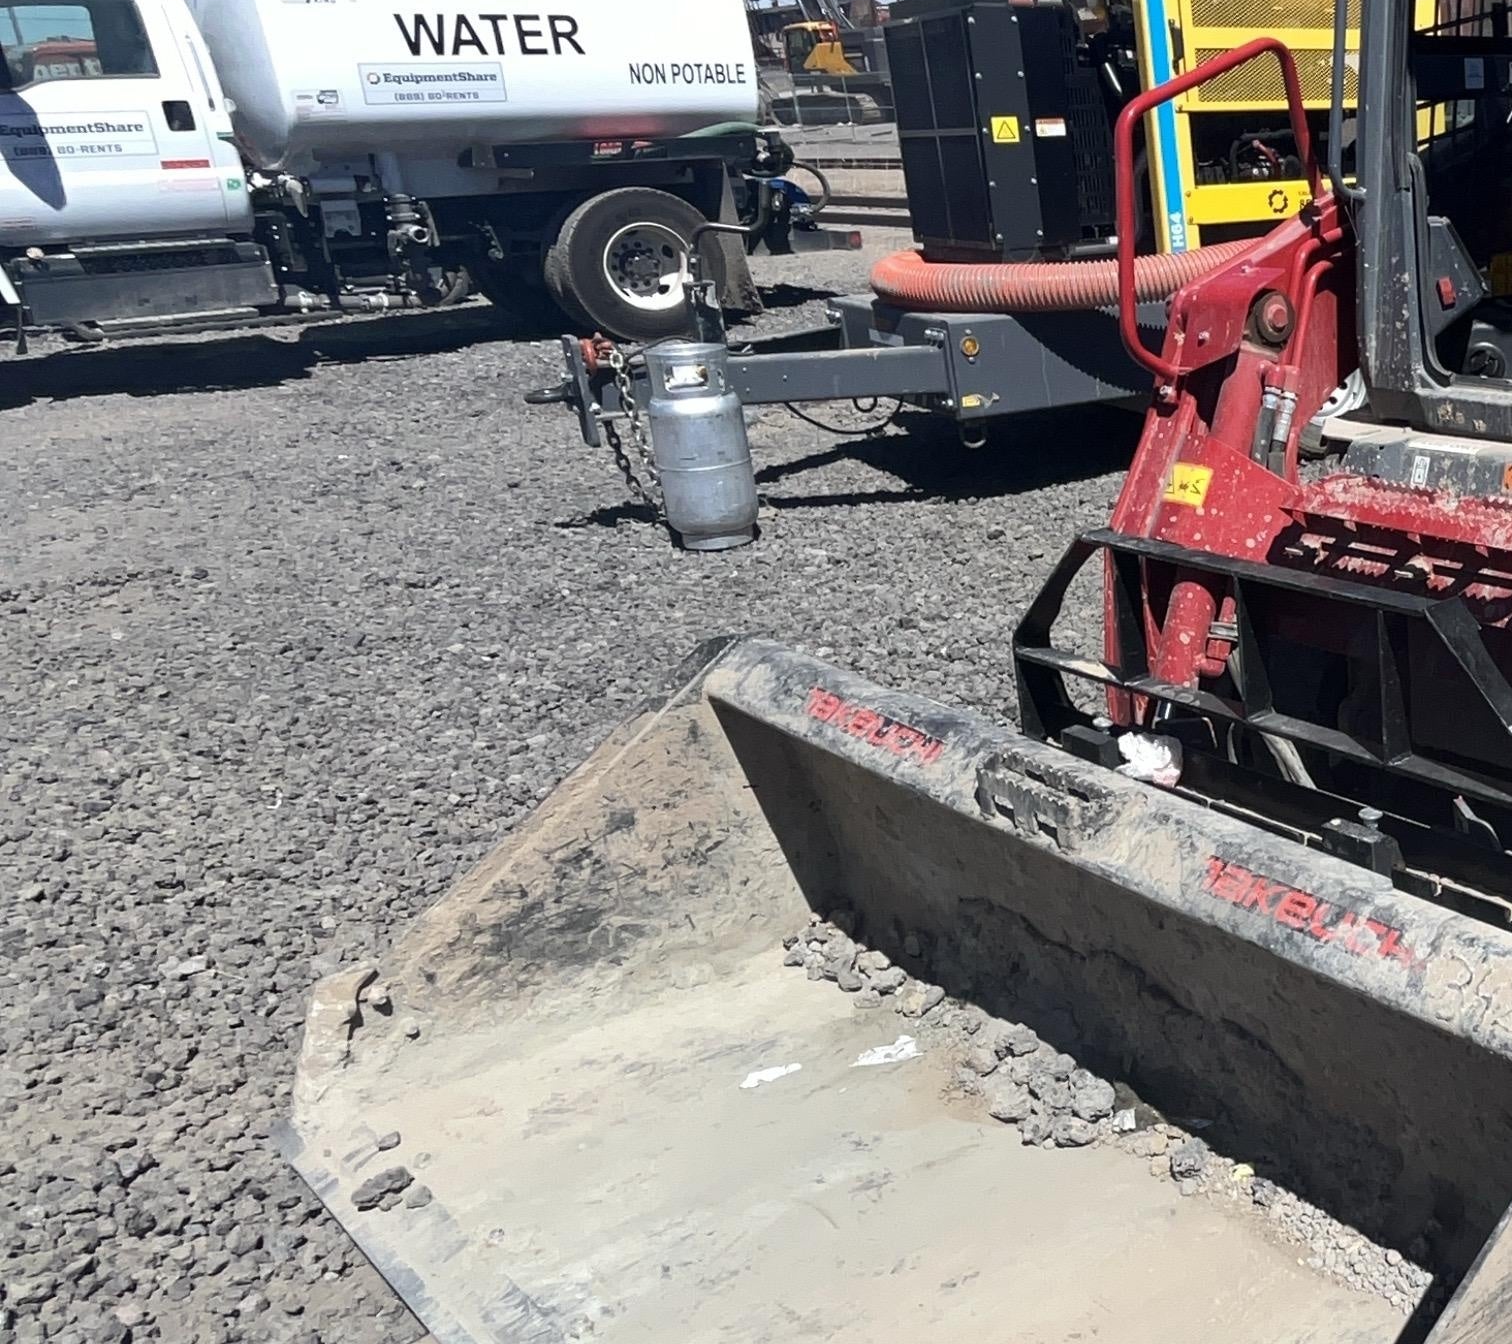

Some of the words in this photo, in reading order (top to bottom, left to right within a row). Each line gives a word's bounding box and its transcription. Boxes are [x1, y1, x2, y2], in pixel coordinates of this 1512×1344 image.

[393, 13, 586, 56] WATER
[382, 71, 498, 86] EquipmentShare
[628, 62, 668, 85] NON
[671, 62, 747, 85] POTABLE
[1169, 212, 1186, 255] H64
